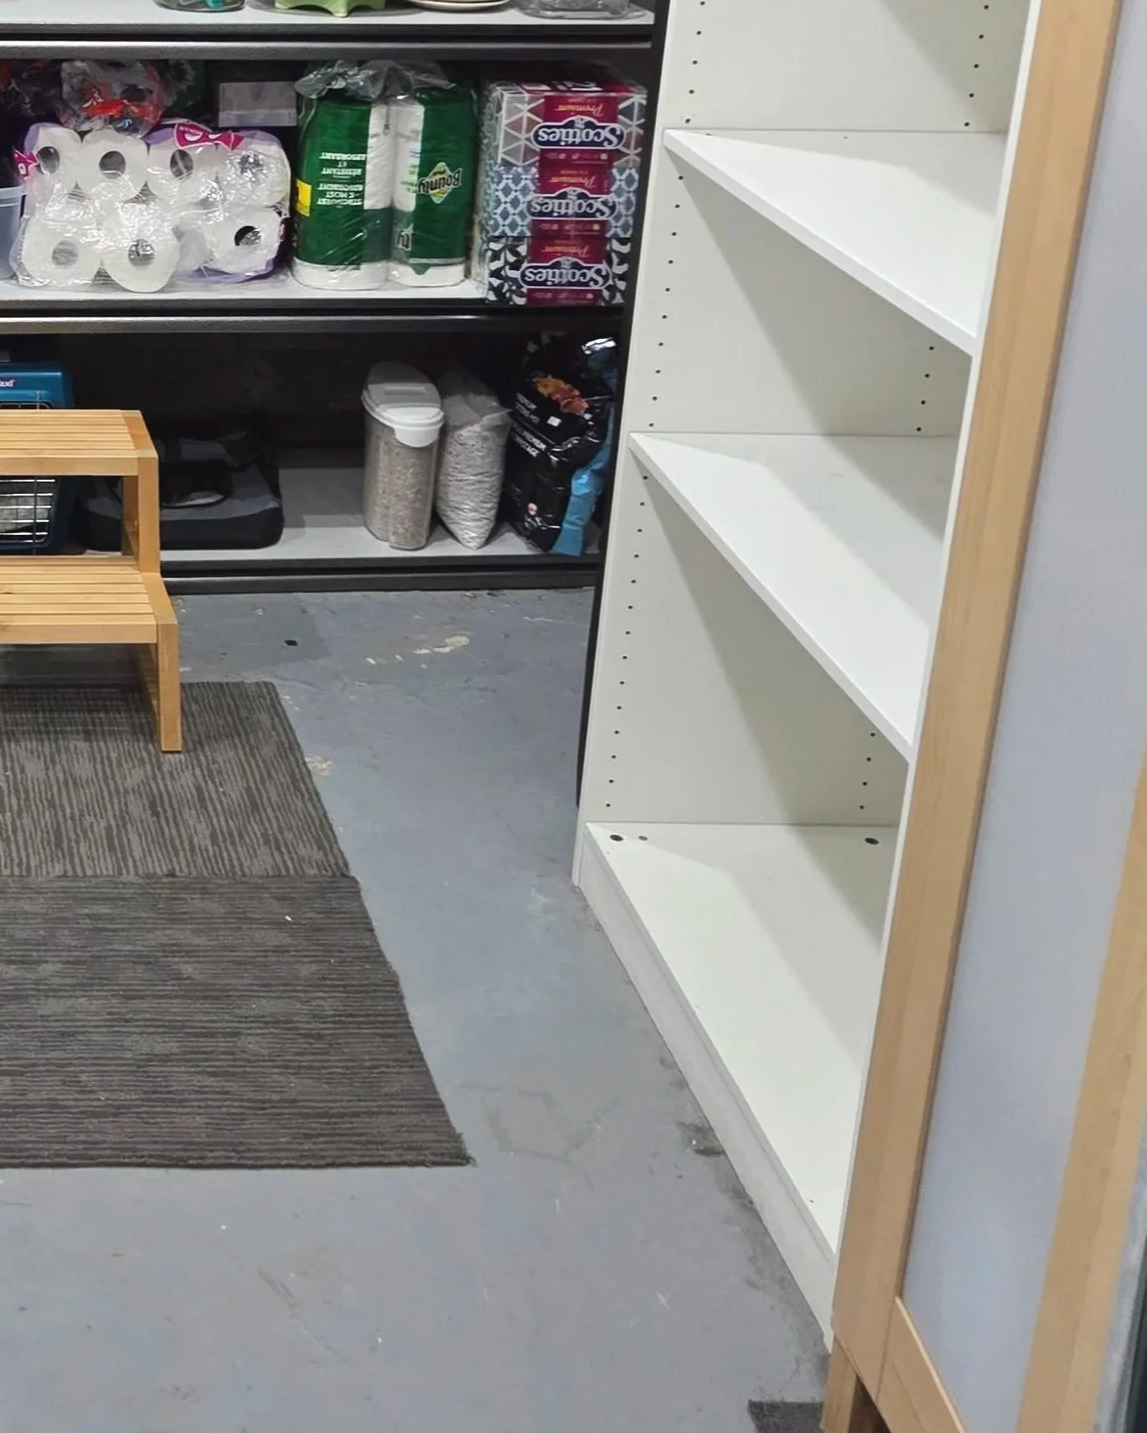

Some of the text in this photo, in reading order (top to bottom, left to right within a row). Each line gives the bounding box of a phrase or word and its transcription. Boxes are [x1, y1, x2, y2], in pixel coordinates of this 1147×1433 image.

[538, 125, 621, 149] Scotties
[417, 168, 463, 195] Bounty
[530, 197, 614, 219] Scotties
[524, 265, 607, 288] Scotties
